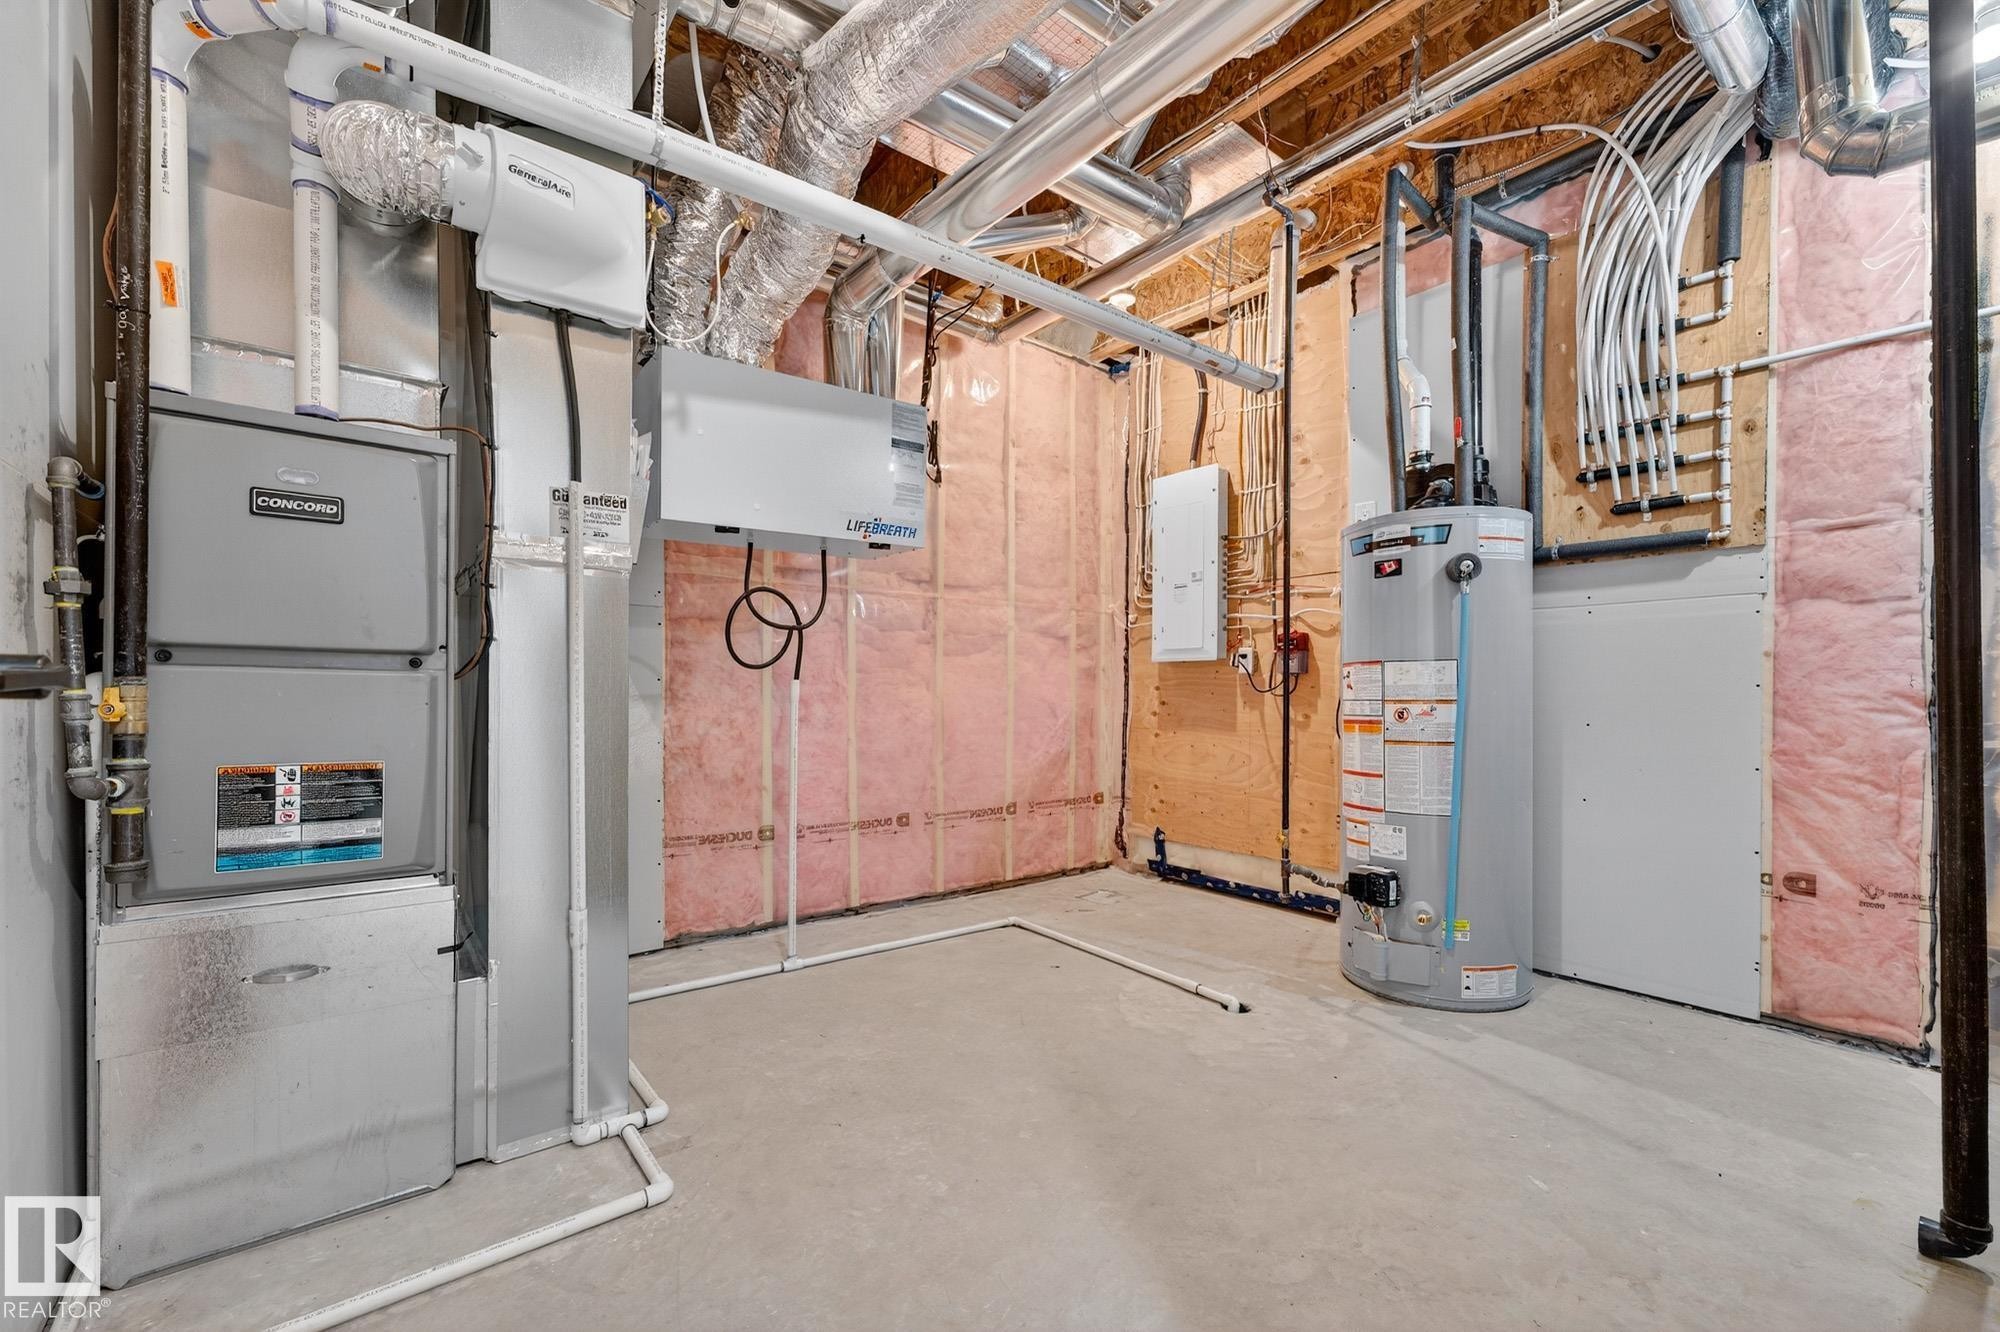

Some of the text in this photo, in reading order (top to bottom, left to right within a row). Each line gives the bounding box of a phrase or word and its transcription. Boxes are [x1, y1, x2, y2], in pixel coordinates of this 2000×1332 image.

[508, 164, 571, 198] GeneralAire
[257, 496, 338, 514] CONCORD
[552, 489, 627, 510] Guanteed
[846, 519, 917, 539] LIFEBREATH
